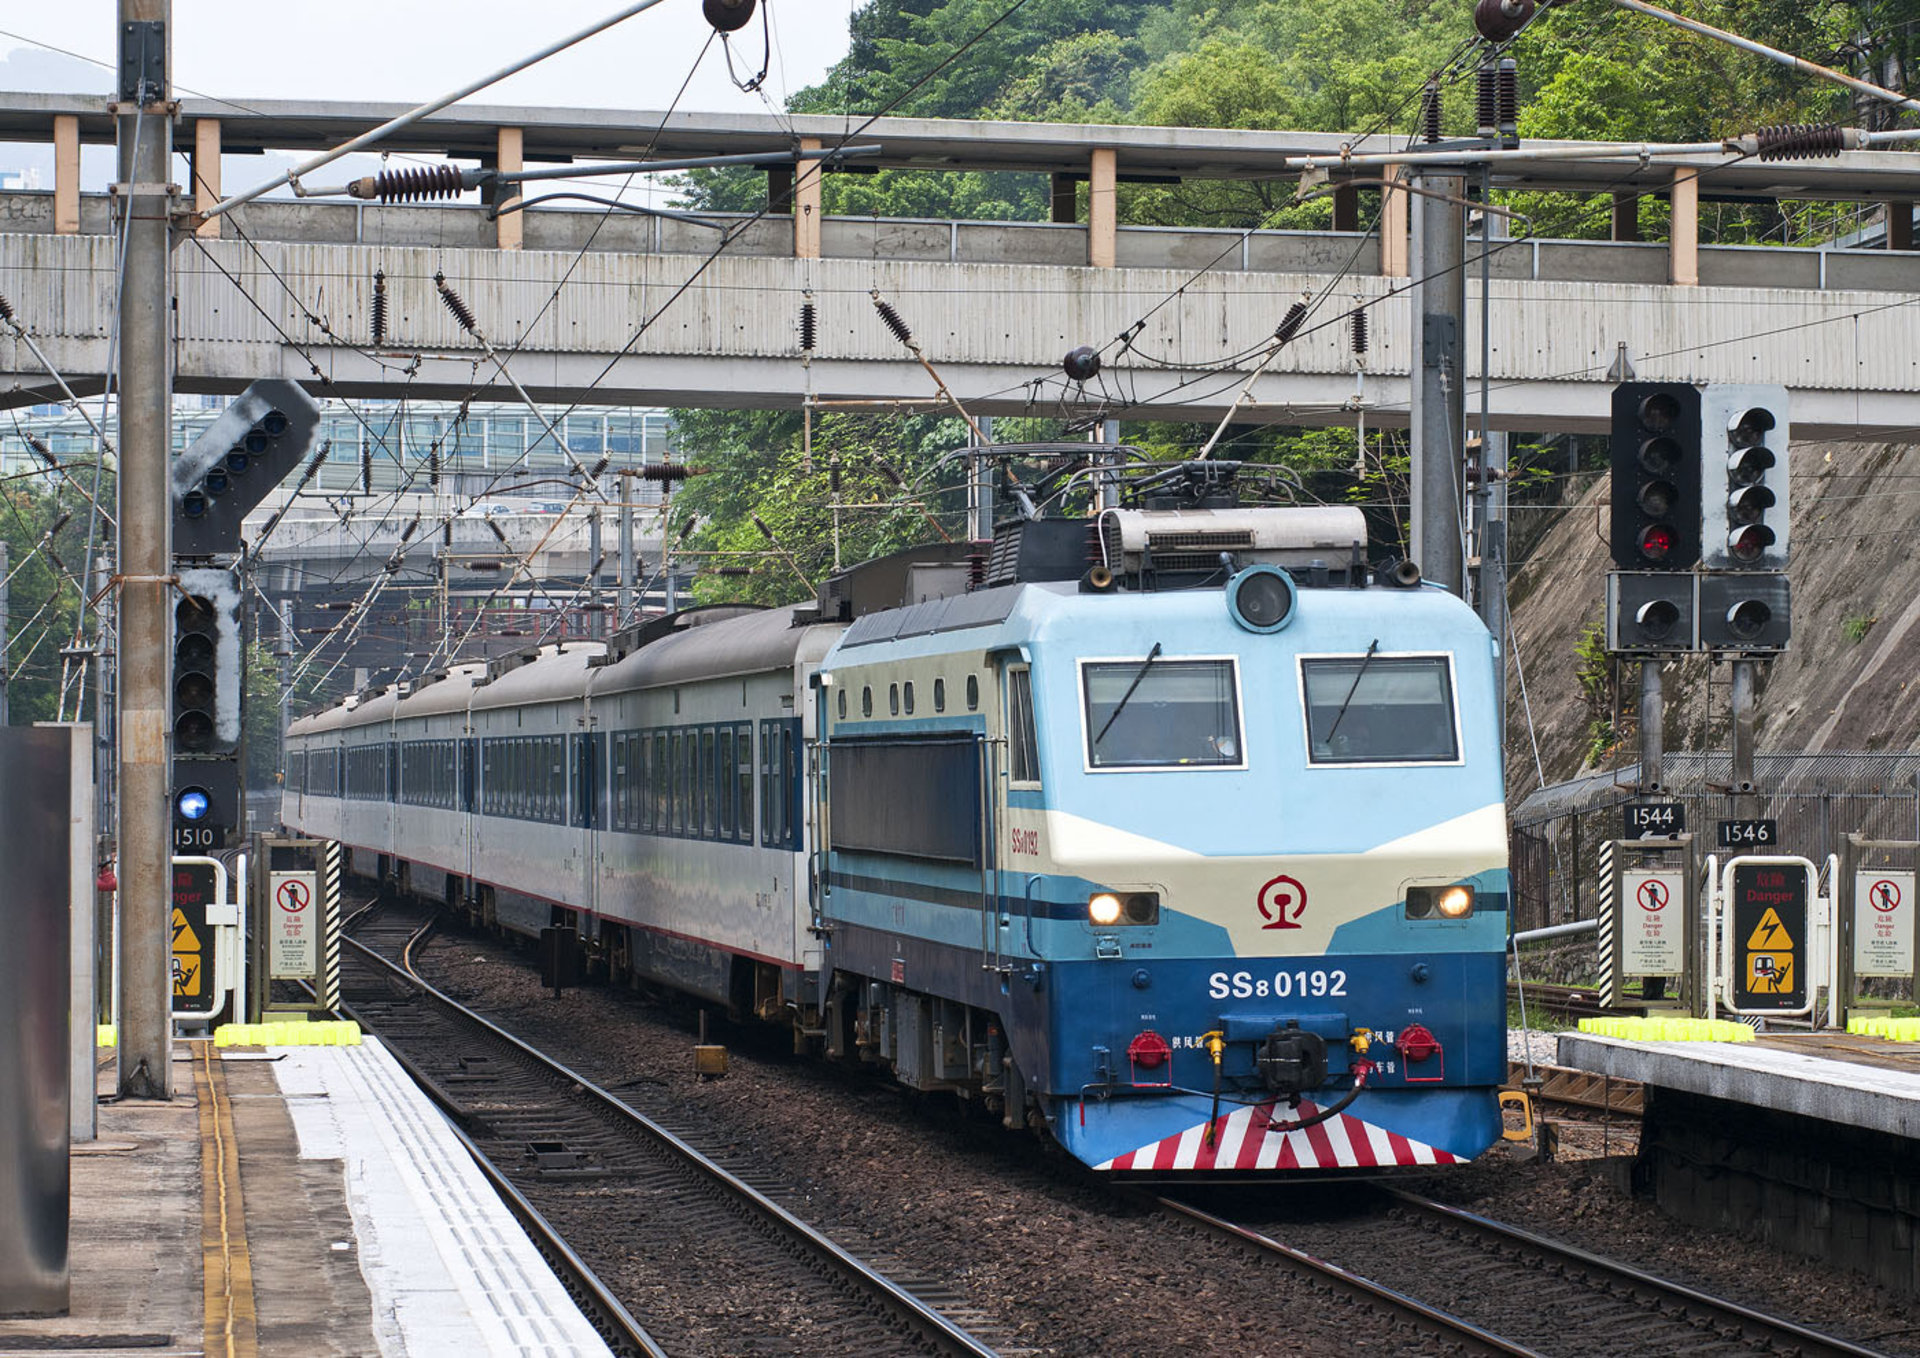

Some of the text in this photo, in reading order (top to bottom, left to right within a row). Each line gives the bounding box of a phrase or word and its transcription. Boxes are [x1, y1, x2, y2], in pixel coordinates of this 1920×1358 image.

[1634, 807, 1674, 825] 1544
[175, 828, 213, 846] 1510
[1725, 824, 1768, 842] 1546
[1747, 889, 1793, 904] Danger
[1369, 1061, 1396, 1074] 车管
